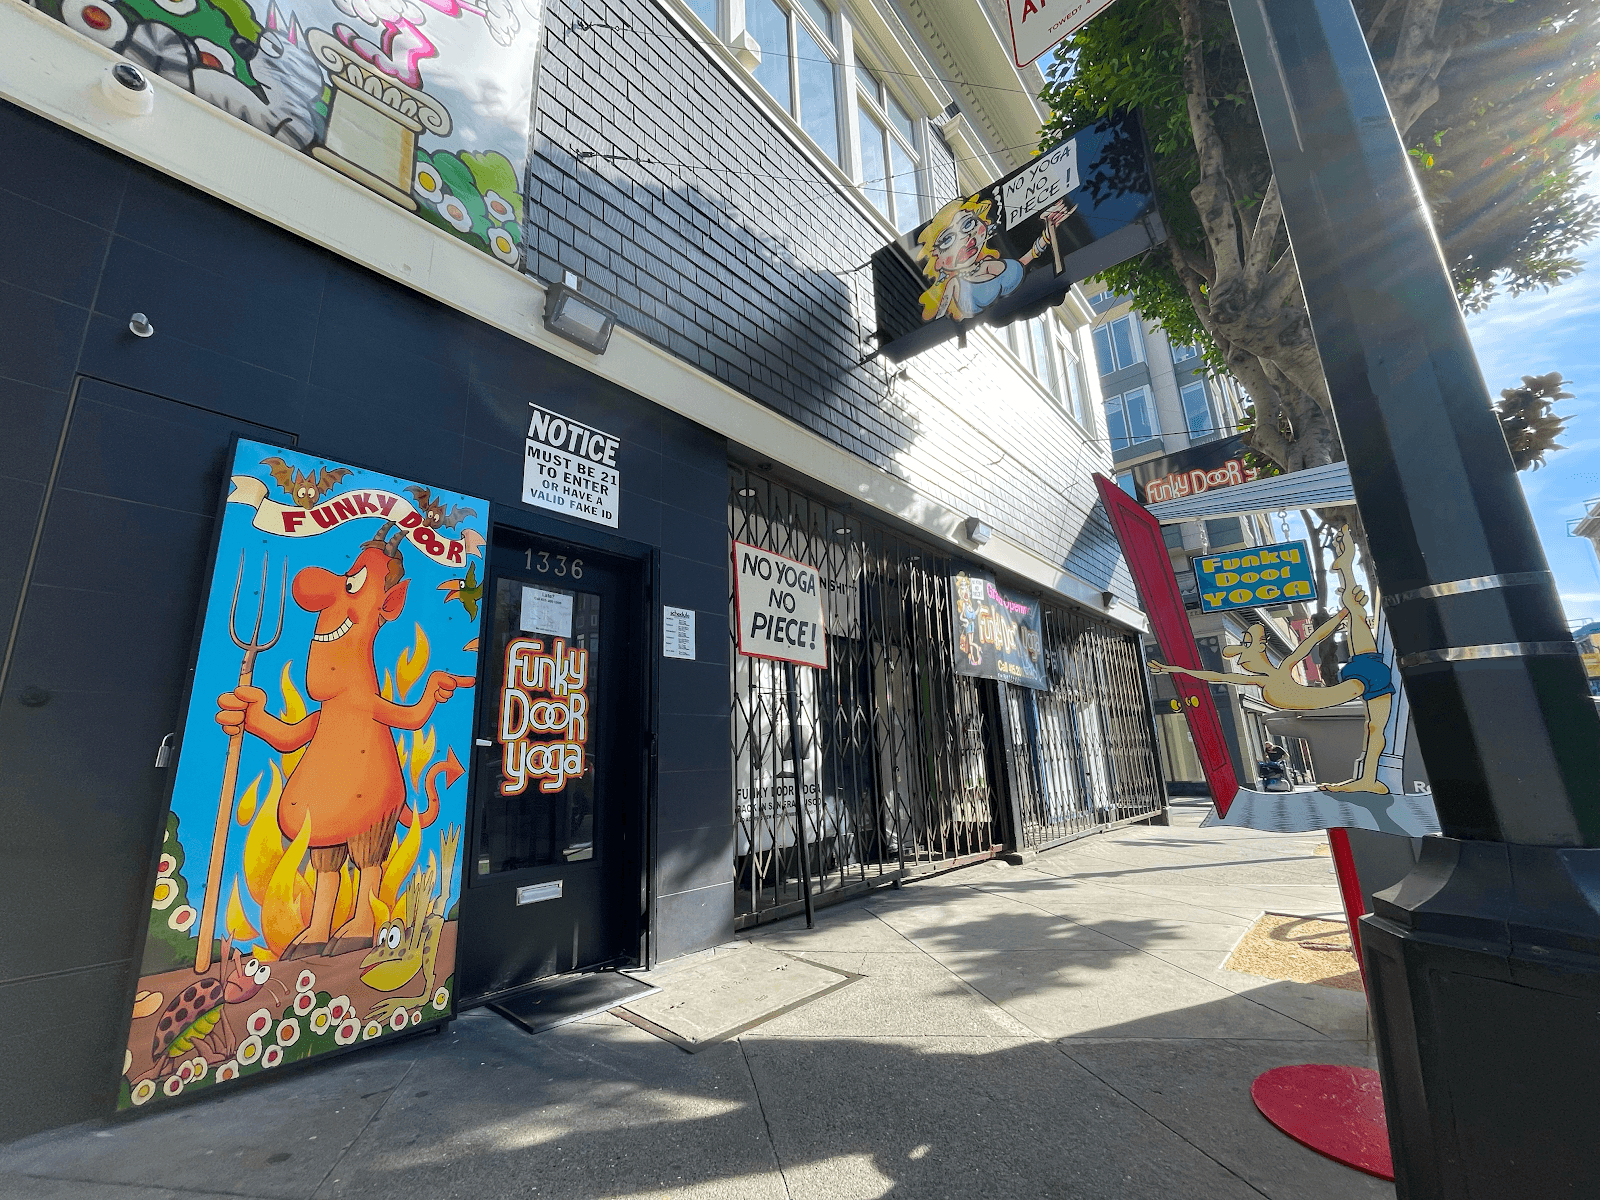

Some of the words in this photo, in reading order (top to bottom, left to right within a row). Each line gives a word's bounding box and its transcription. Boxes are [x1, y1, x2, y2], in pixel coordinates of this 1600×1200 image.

[1021, 0, 1046, 24] A
[1048, 4, 1082, 33] TOWED?
[1006, 176, 1025, 199] NO
[1029, 145, 1072, 183] YOGA
[1025, 176, 1048, 201] NO
[527, 409, 620, 467] NOTICE
[527, 445, 572, 470] MUST
[577, 462, 596, 478] BE
[600, 471, 617, 486] 21
[537, 462, 557, 479] TO
[563, 471, 609, 496] ENTER
[530, 487, 565, 506] VALID
[569, 499, 598, 516] FAKE
[601, 509, 613, 520] ID
[542, 479, 559, 492] OR
[563, 485, 593, 503] HAVE
[596, 496, 603, 506] A
[1145, 474, 1189, 503] Funky
[281, 492, 398, 533] FUNKY
[398, 511, 464, 564] DOOR
[524, 547, 584, 580] 1336
[742, 552, 772, 581] NO
[775, 561, 816, 597] YOGA
[1202, 548, 1301, 573] Funky
[1215, 565, 1291, 587] Door
[768, 588, 796, 614] NO
[1203, 580, 1312, 607] YOGA
[750, 612, 817, 651] PIECE!
[507, 640, 587, 696] Funky
[504, 741, 583, 793] yoga
[768, 800, 783, 812] SN
[771, 785, 795, 798] OOR
